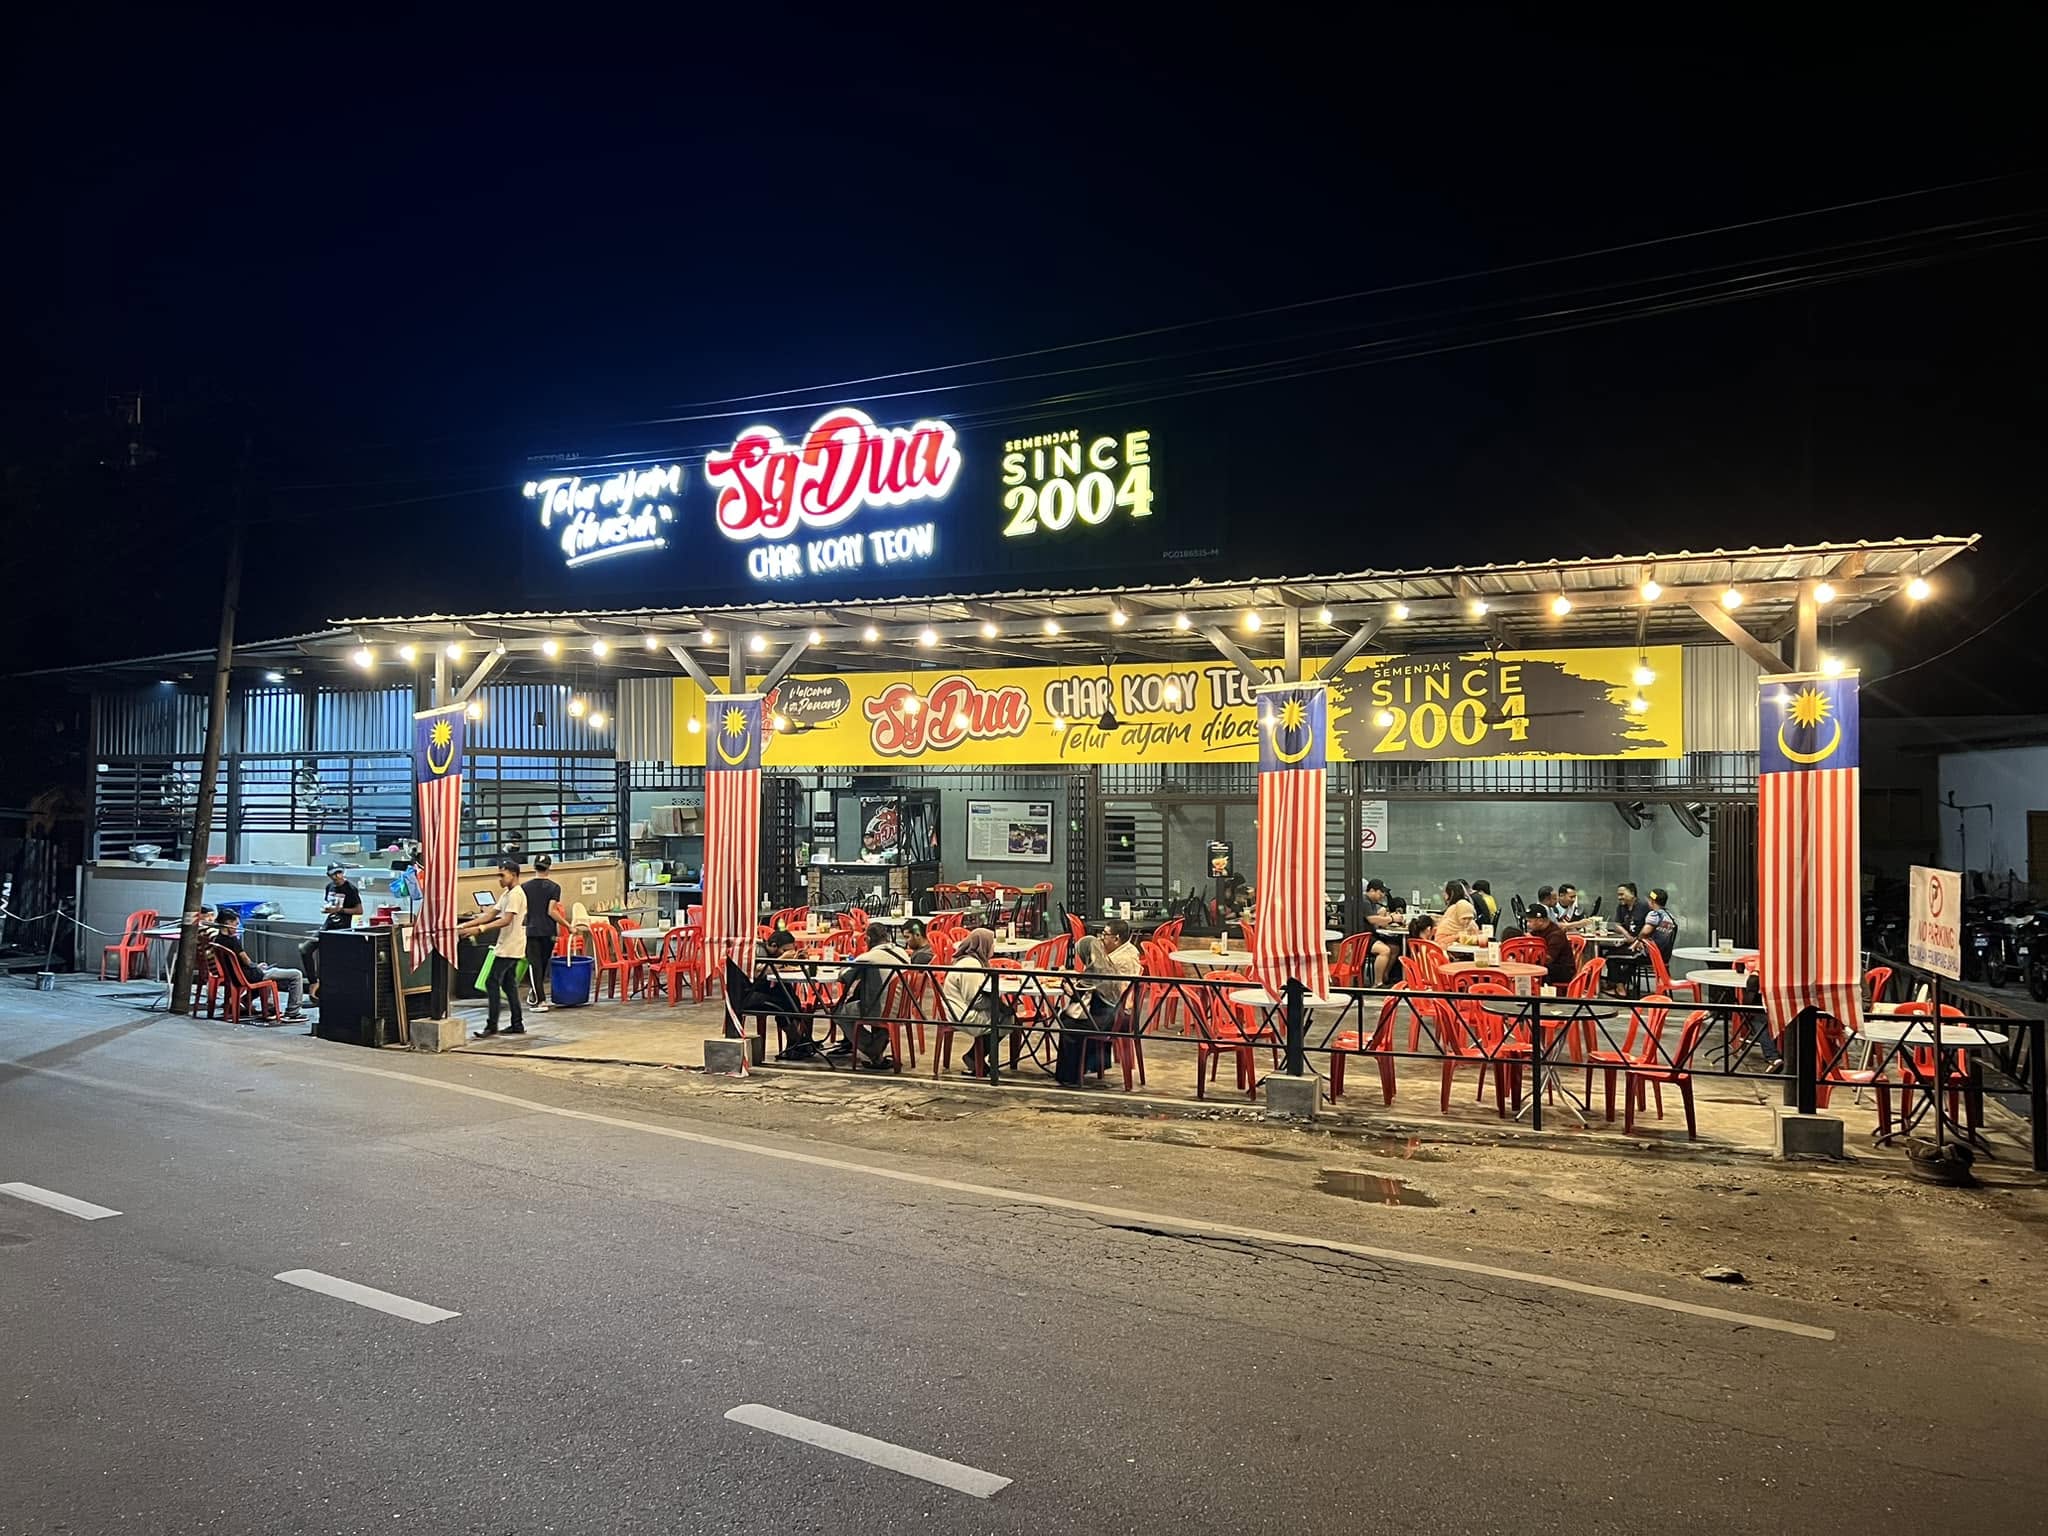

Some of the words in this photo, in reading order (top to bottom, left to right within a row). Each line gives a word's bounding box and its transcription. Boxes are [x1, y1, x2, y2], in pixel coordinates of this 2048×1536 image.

[1002, 431, 1151, 485] SINCE
[1004, 430, 1080, 452] SEMENJAK
[1003, 465, 1154, 537] 2004
[748, 543, 802, 580] CHAR
[808, 533, 865, 574] KOAY
[868, 522, 936, 565] TEOW
[1371, 665, 1522, 706] SINCE
[1374, 662, 1451, 678] SEMENJAK
[789, 685, 833, 699] Welcome
[798, 698, 842, 714] Penang
[1045, 677, 1116, 718] CHAR
[1204, 667, 1285, 710] TEO
[1121, 722, 1192, 755] ayam
[1372, 694, 1530, 753] 2004
[1918, 919, 1928, 942] NO
[1928, 922, 1955, 950] PARKING
